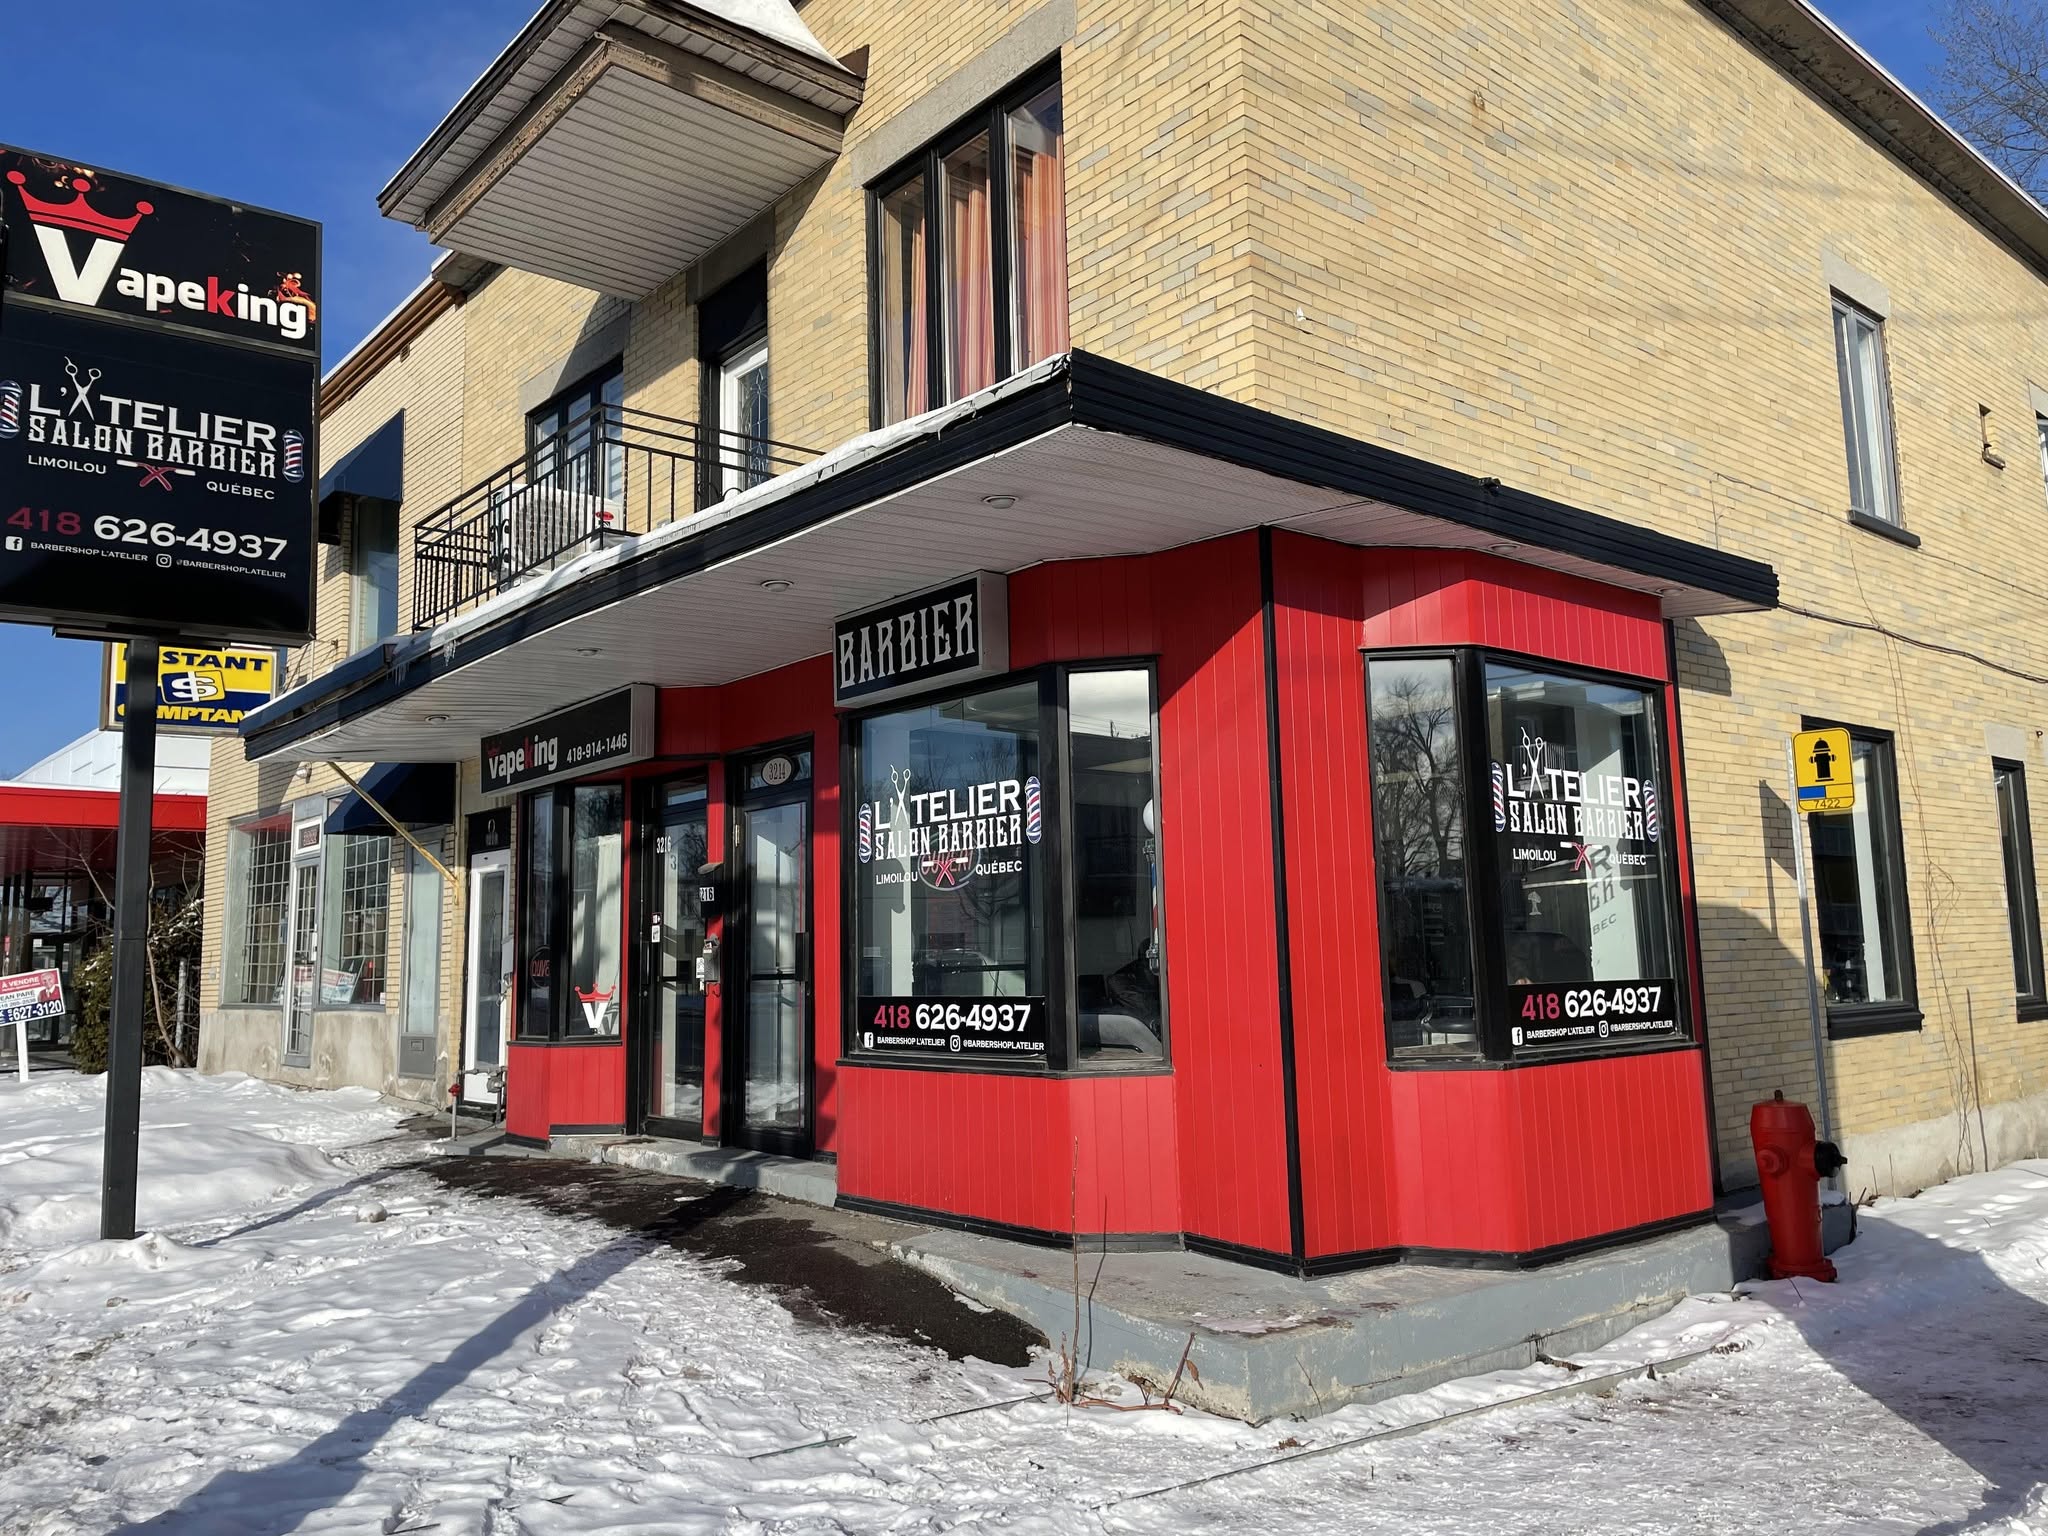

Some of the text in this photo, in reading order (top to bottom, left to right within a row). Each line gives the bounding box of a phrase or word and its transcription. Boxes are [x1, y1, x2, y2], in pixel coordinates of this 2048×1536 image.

[32, 223, 307, 339] Vapeking
[28, 414, 276, 479] SALON BARBIER
[28, 454, 275, 500] LIMOILOU QUÉBEC
[7, 507, 288, 561] 418 626-4937
[30, 541, 100, 556] BARBERSHOP
[101, 550, 148, 563] L'ATELIER
[838, 594, 975, 689] BARBIER
[124, 647, 268, 671] STANT
[566, 733, 627, 763] 418-914-1446
[1813, 798, 1840, 809] 7422
[1509, 801, 1645, 840] SALON BARBIER
[656, 836, 672, 853] 3216
[875, 814, 1022, 861] SALON BARBIER
[1513, 848, 1647, 866] LIMOILOU QUÉBEC
[876, 860, 1022, 884] LIMOILOU QUÉBEC
[9, 976, 39, 987] VENDRE
[13, 1000, 61, 1020] 627-3120
[1522, 986, 1661, 1020] 418 626-4937
[874, 1003, 1031, 1032] 418 626-4937
[1527, 1028, 1567, 1039] BARBERSHOP
[1610, 1020, 1673, 1032] @BARBERSHOPLATELIER
[877, 1036, 916, 1045] BARBERSHOP
[916, 1038, 945, 1046] L'ATELIER
[963, 1040, 1044, 1051] @BARBERSHOPLATELIER
